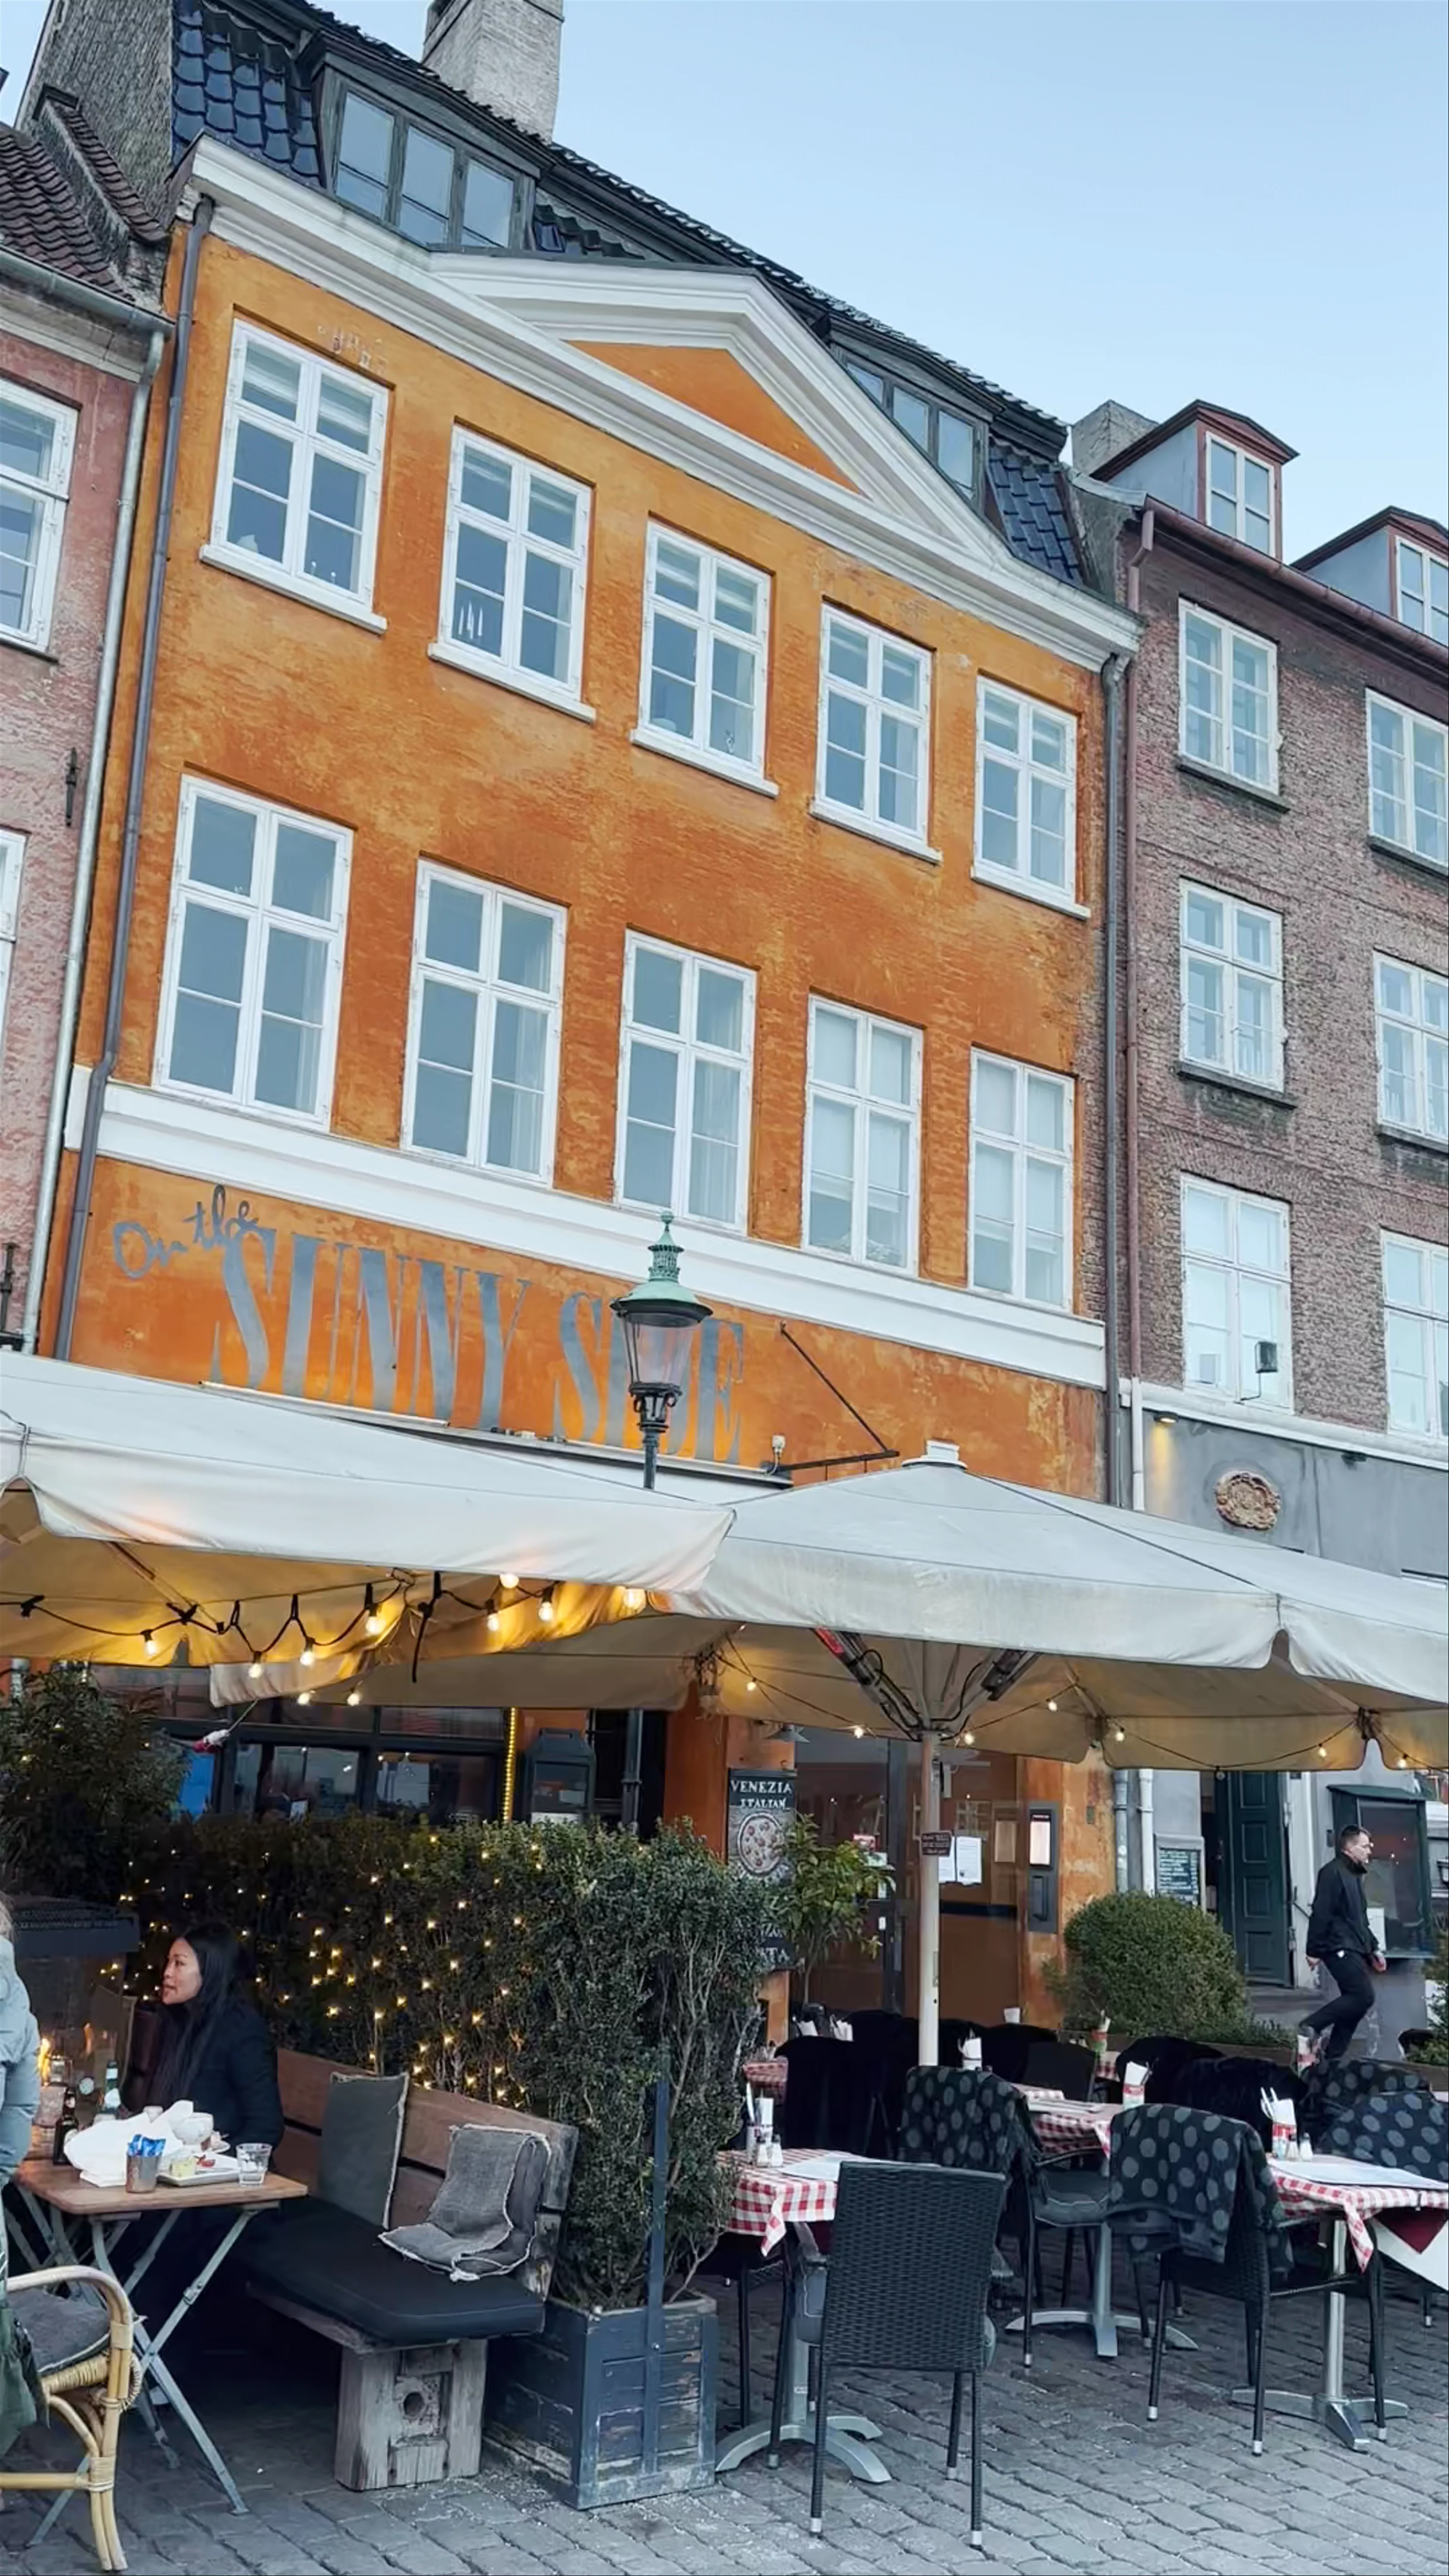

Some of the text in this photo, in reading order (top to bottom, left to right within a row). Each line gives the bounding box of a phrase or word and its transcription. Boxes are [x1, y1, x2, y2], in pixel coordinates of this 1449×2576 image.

[114, 1184, 260, 1280] On the
[209, 1225, 743, 1465] SUNNY SIDE
[730, 1779, 792, 1793] VENEZIA
[740, 1798, 786, 1809] ITALIAN
